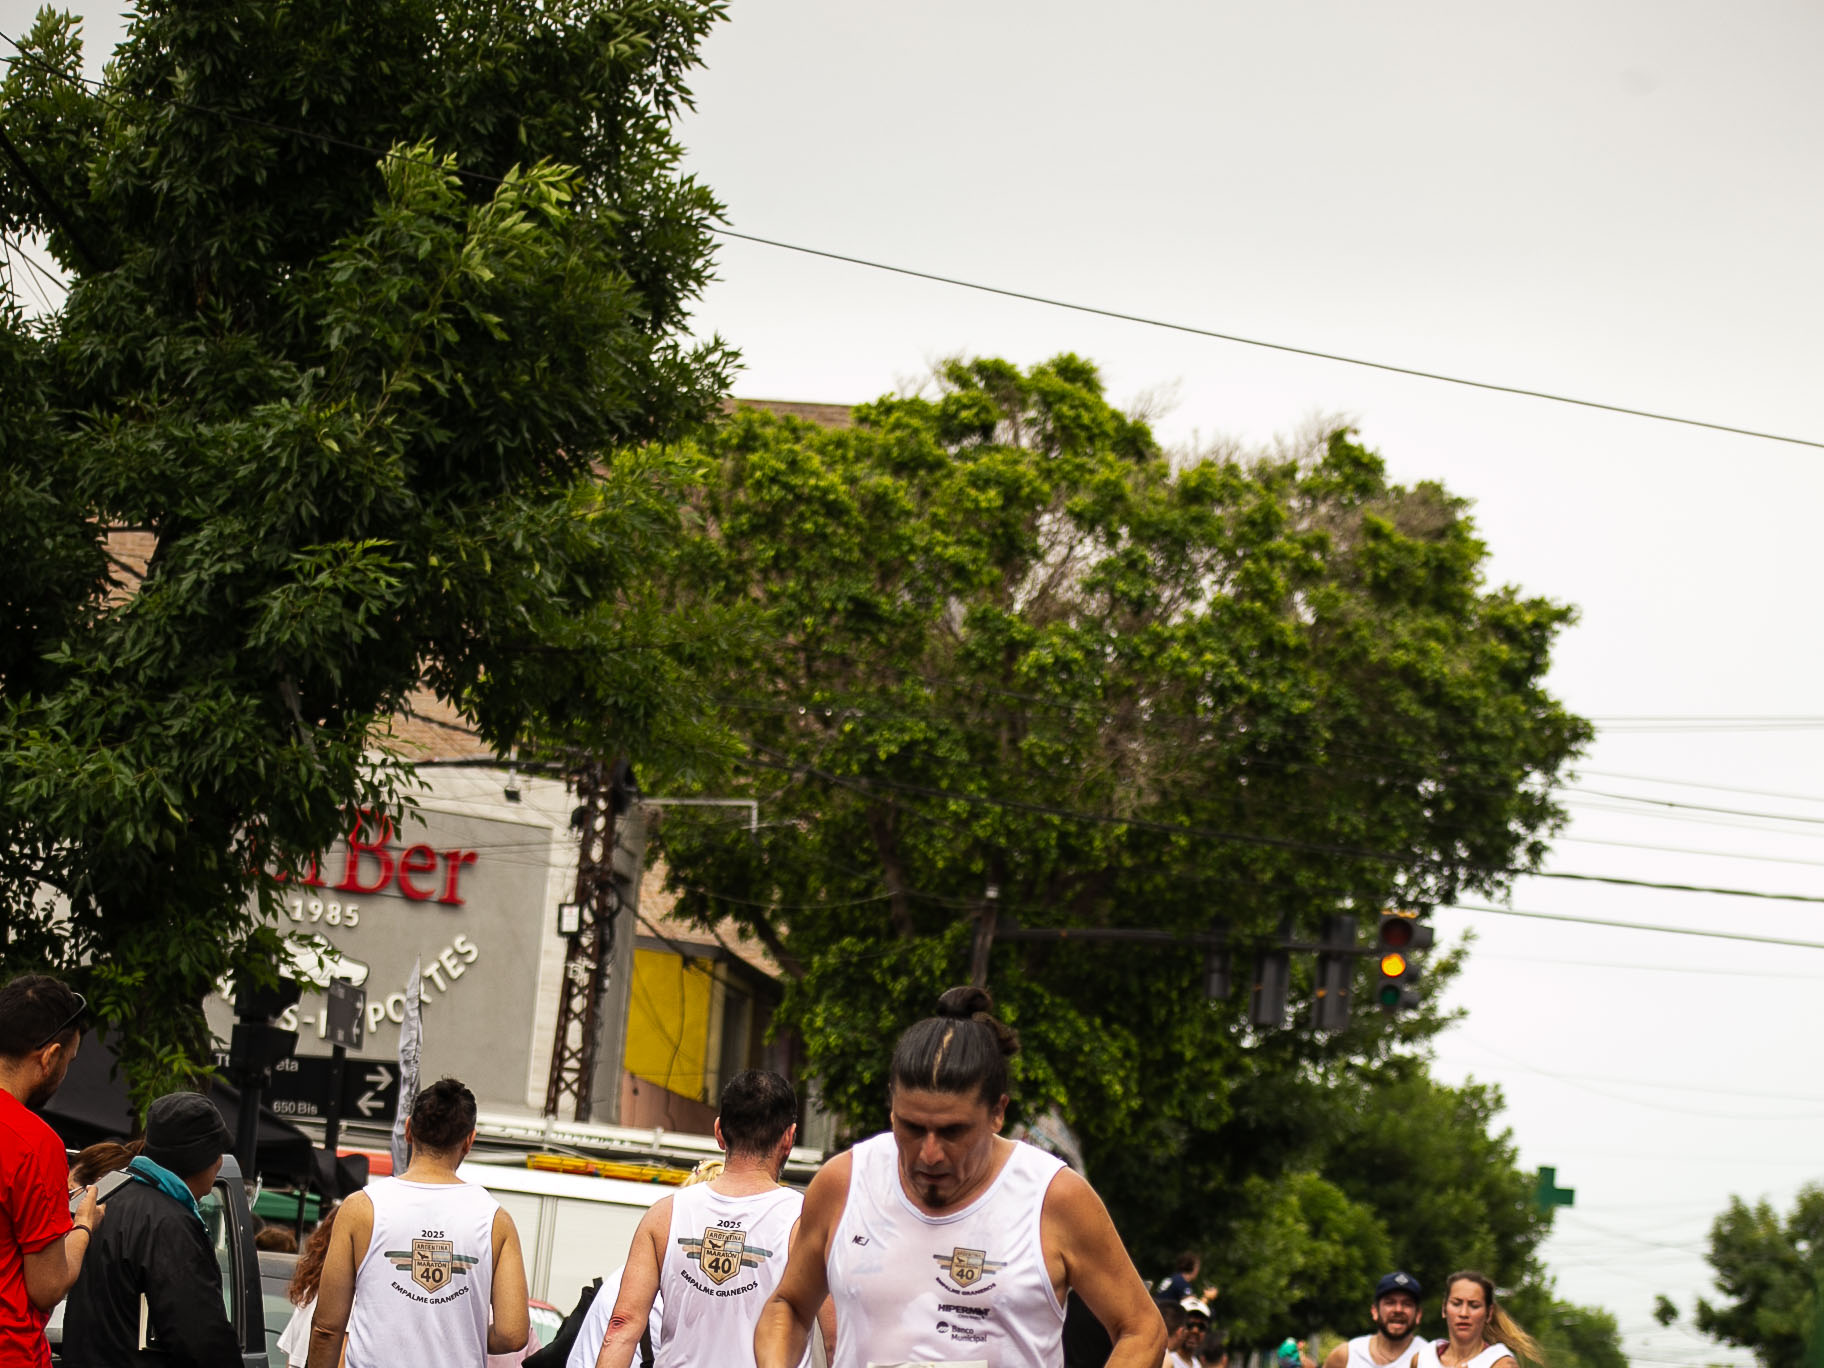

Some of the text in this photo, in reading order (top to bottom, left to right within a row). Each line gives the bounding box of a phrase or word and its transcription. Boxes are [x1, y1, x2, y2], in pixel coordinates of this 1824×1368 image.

[289, 899, 361, 928] 1985
[273, 1101, 318, 1116] 650 Bis
[717, 1219, 742, 1229] 2025
[421, 1229, 445, 1239] 2025
[709, 1232, 742, 1241] ARGENTINA
[416, 1243, 448, 1251] ARGENTINA
[707, 1257, 732, 1275] 40
[420, 1267, 444, 1284] 40
[956, 1269, 975, 1281] 40
[680, 1269, 759, 1298] EMPALME GRANEROS
[391, 1281, 470, 1305] EMPALME GRANEROS
[951, 1325, 974, 1335] Banco
[951, 1333, 987, 1344] Municipal
